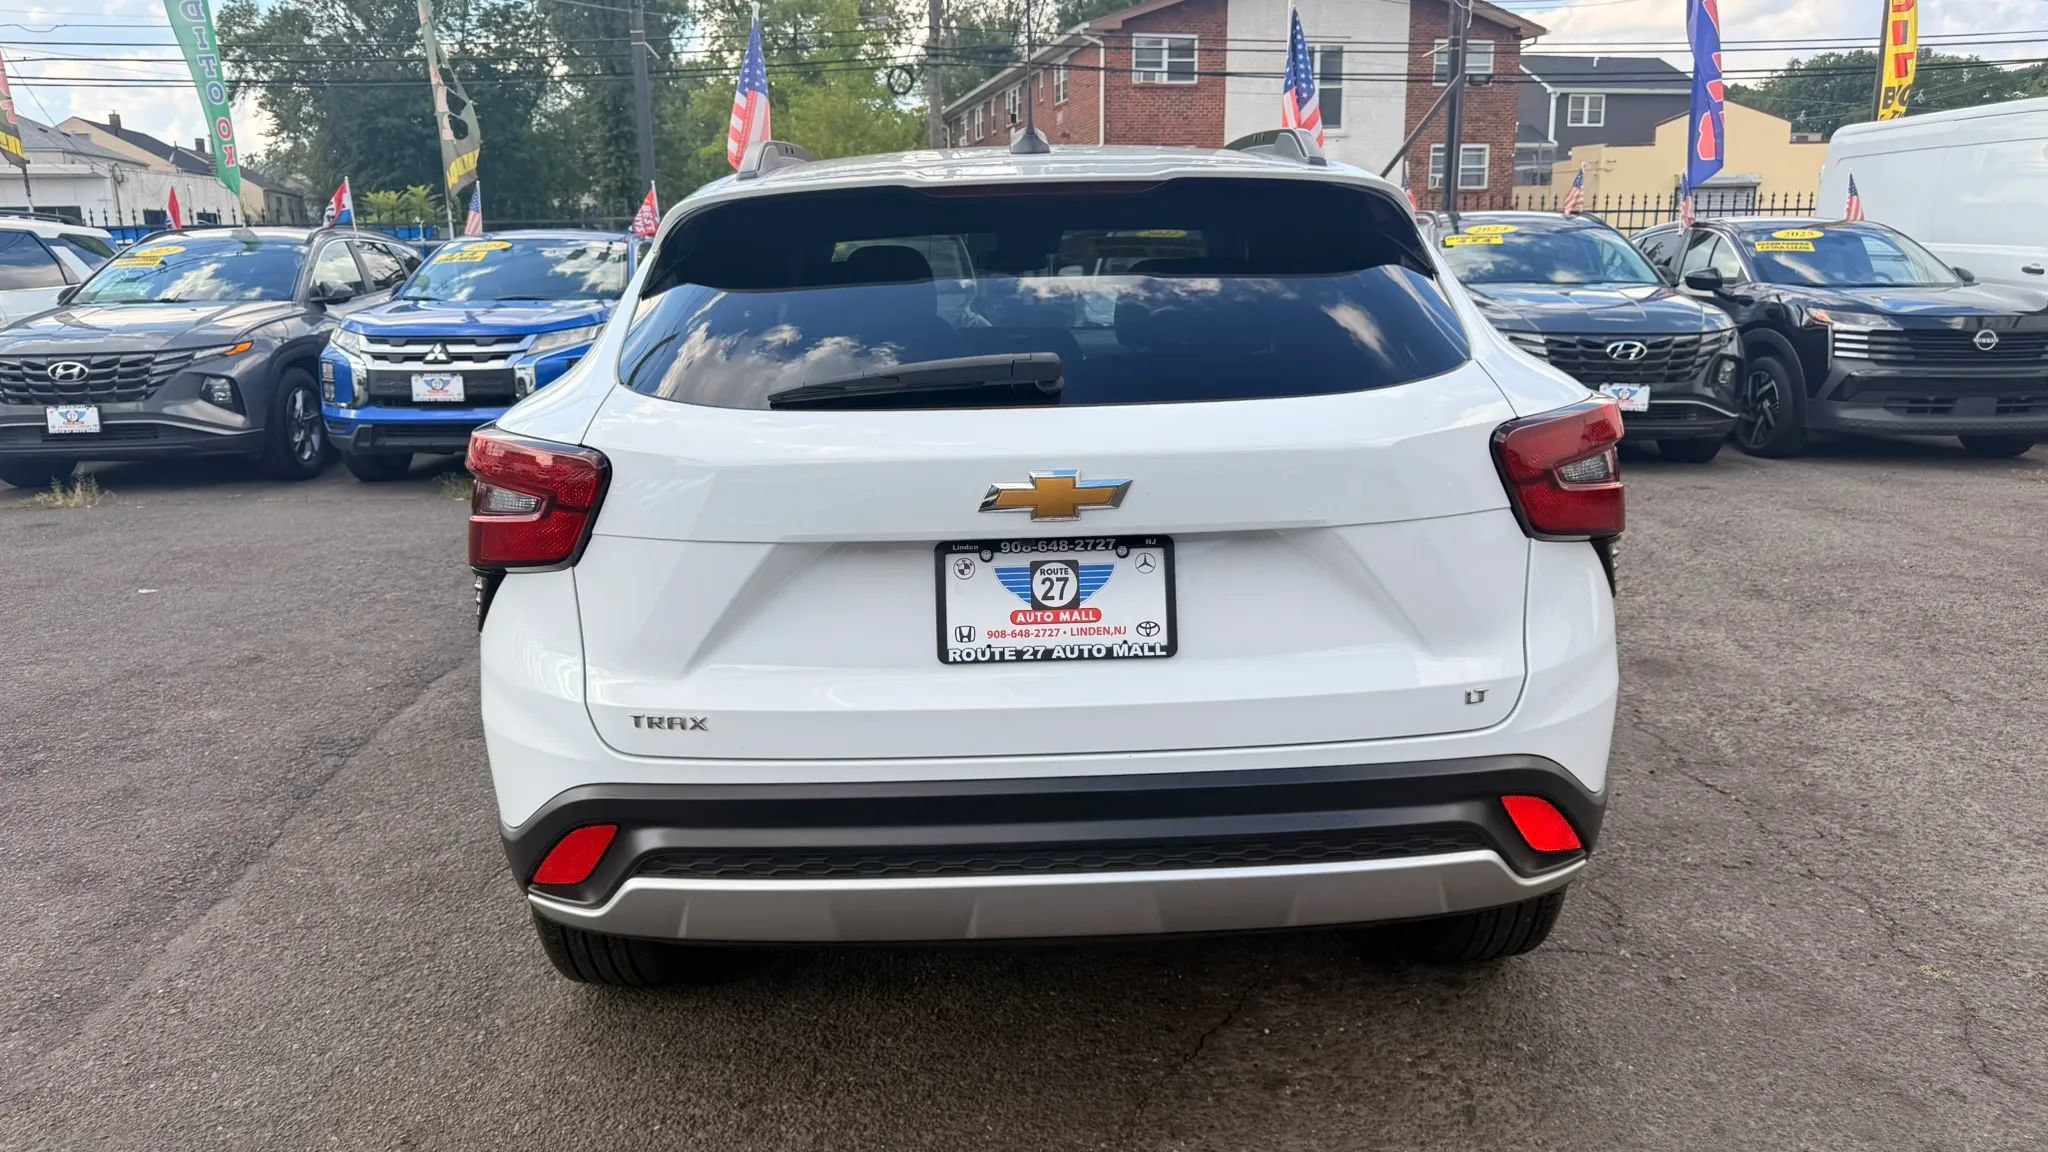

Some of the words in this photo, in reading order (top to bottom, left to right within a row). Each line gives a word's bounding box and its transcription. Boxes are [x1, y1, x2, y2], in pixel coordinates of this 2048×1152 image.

[1039, 567, 1069, 576] ROUTE
[1040, 577, 1069, 601] 27
[1016, 612, 1054, 624] AUTO
[1060, 610, 1096, 622] MALL
[986, 628, 1061, 639] 908-648-2727
[1070, 626, 1127, 637] LINDEN,NJ
[948, 647, 1016, 663] ROUTE
[1022, 645, 1046, 660] 27
[1052, 644, 1107, 659] AUTO
[1112, 642, 1167, 657] MALL
[1464, 688, 1489, 705] LT
[629, 714, 708, 731] TRAX
